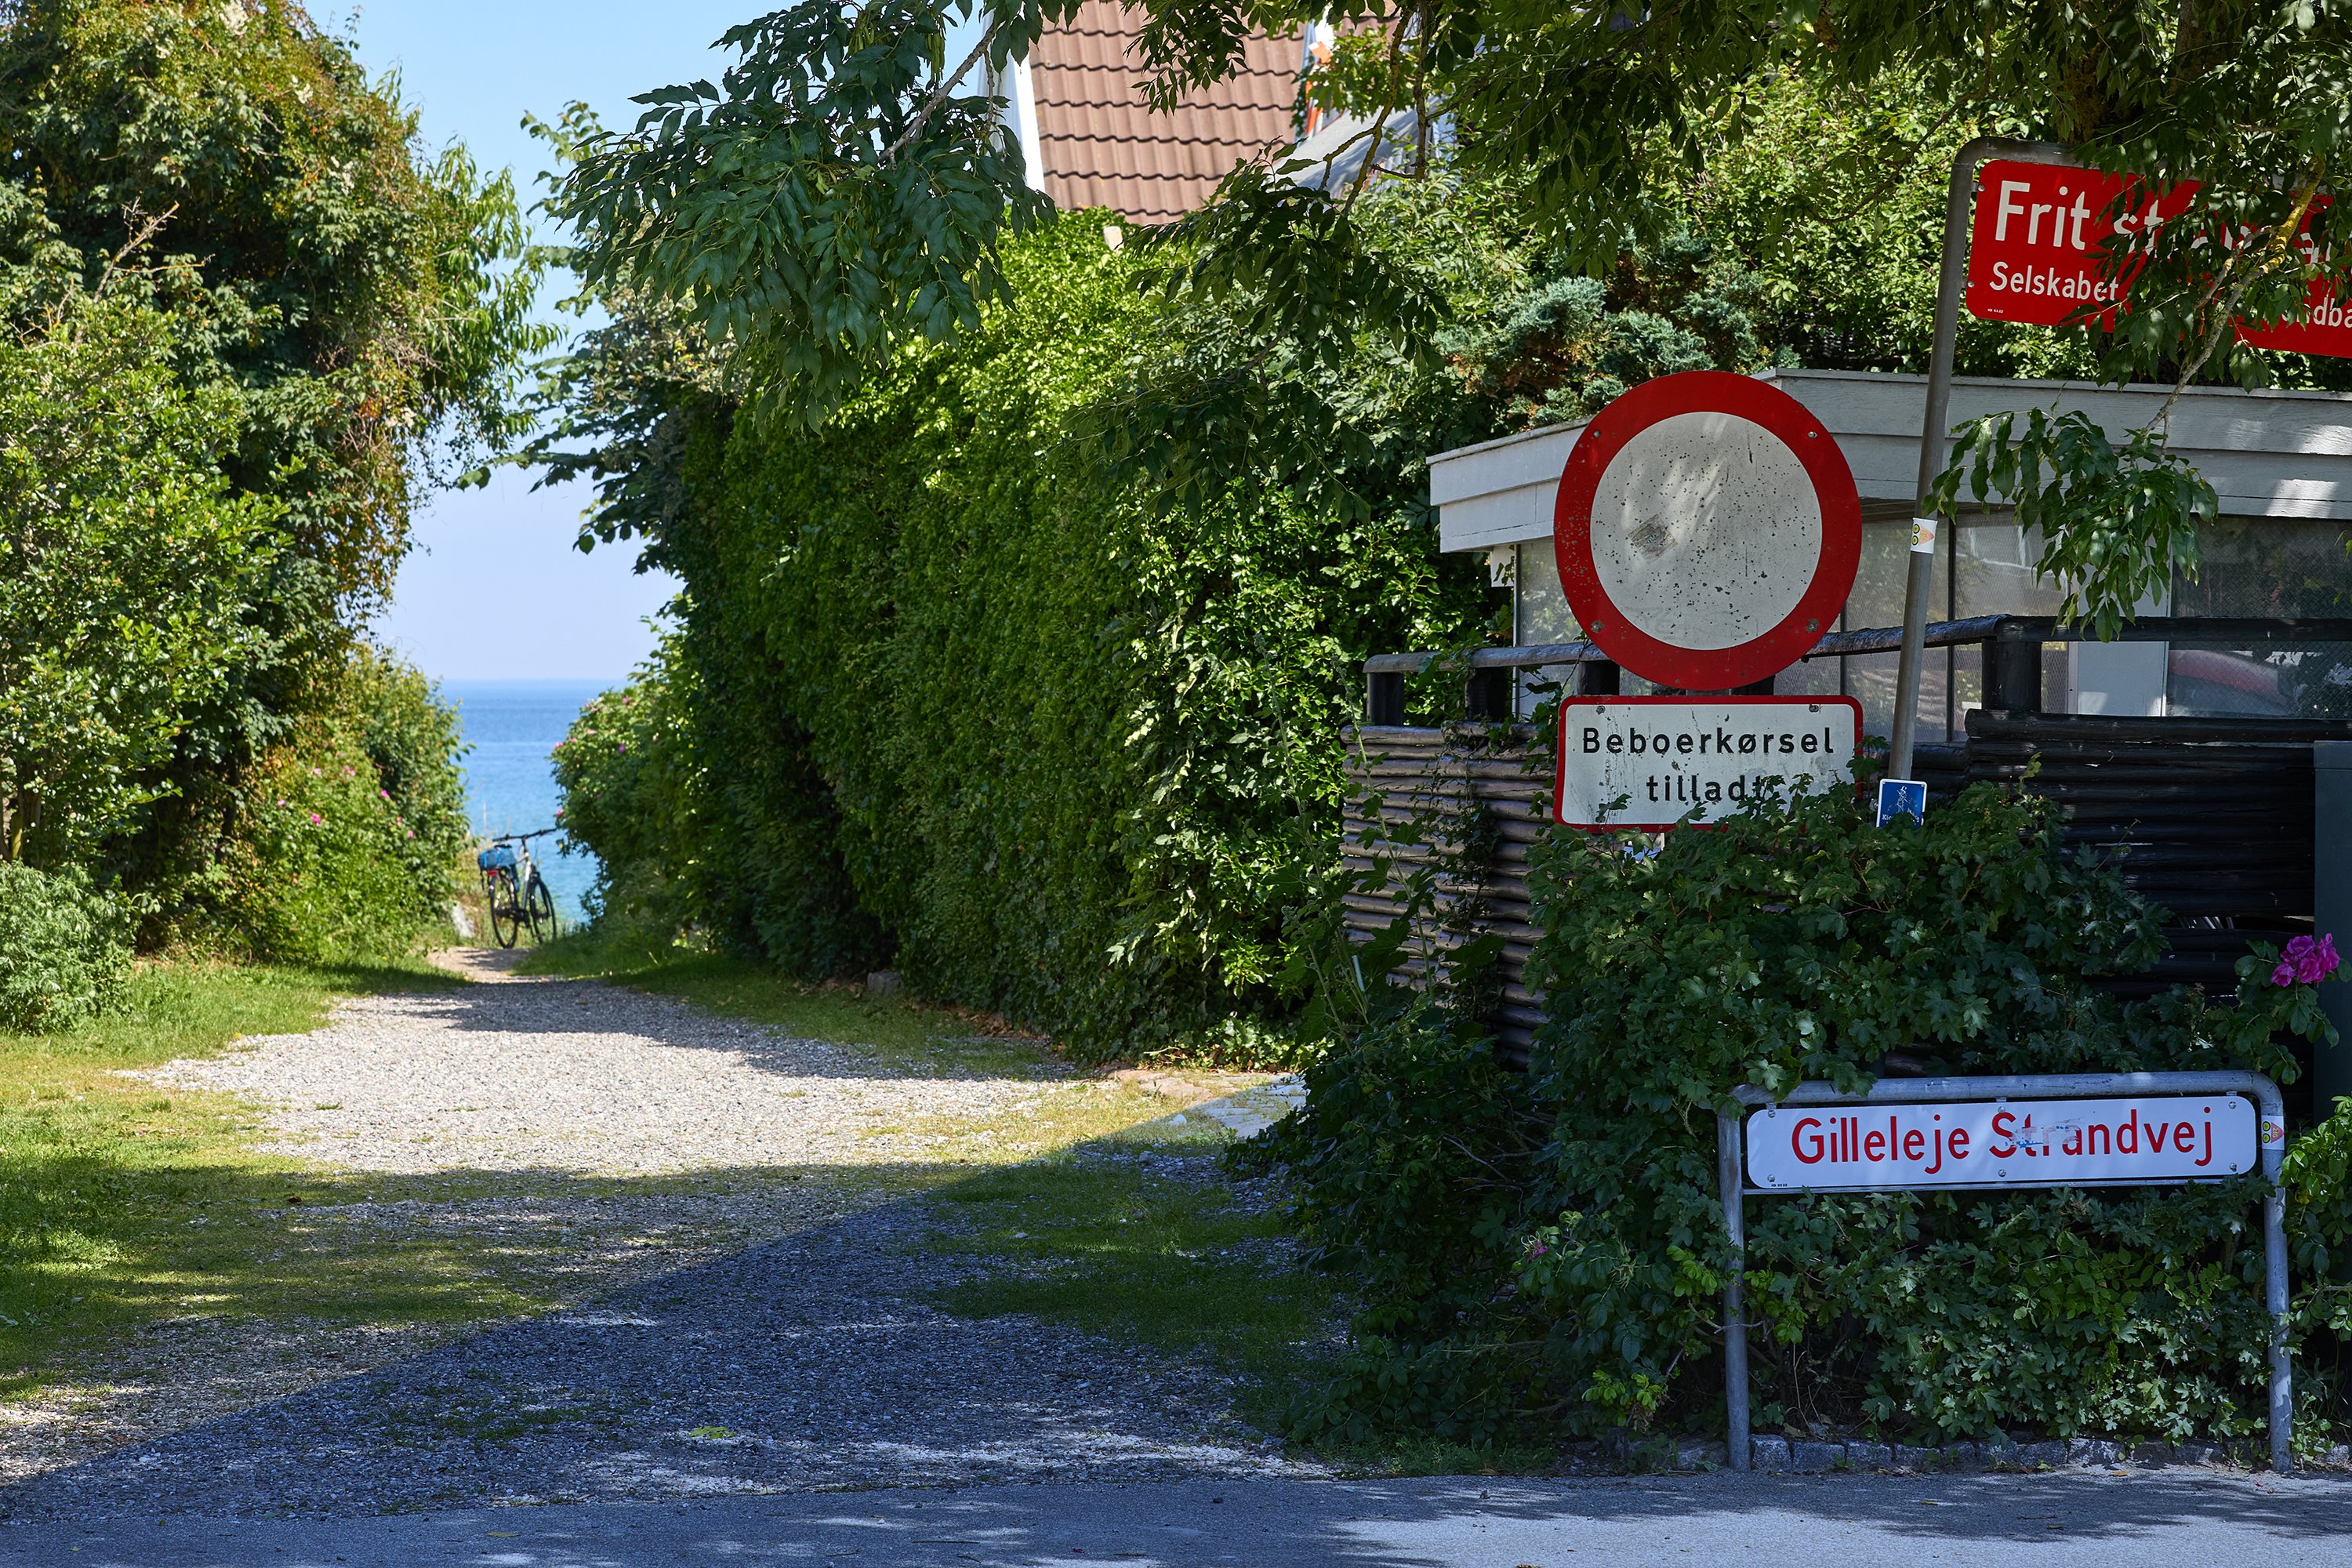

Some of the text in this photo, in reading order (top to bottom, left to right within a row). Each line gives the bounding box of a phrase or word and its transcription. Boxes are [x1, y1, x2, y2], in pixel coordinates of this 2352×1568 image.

[1994, 180, 2091, 251] Frit
[1989, 260, 2120, 303] Selskabet
[1582, 725, 1835, 754] Beboerkørsel
[1646, 775, 1764, 803] tilladt
[1791, 1107, 2212, 1175] Gilleleje Strandvej
